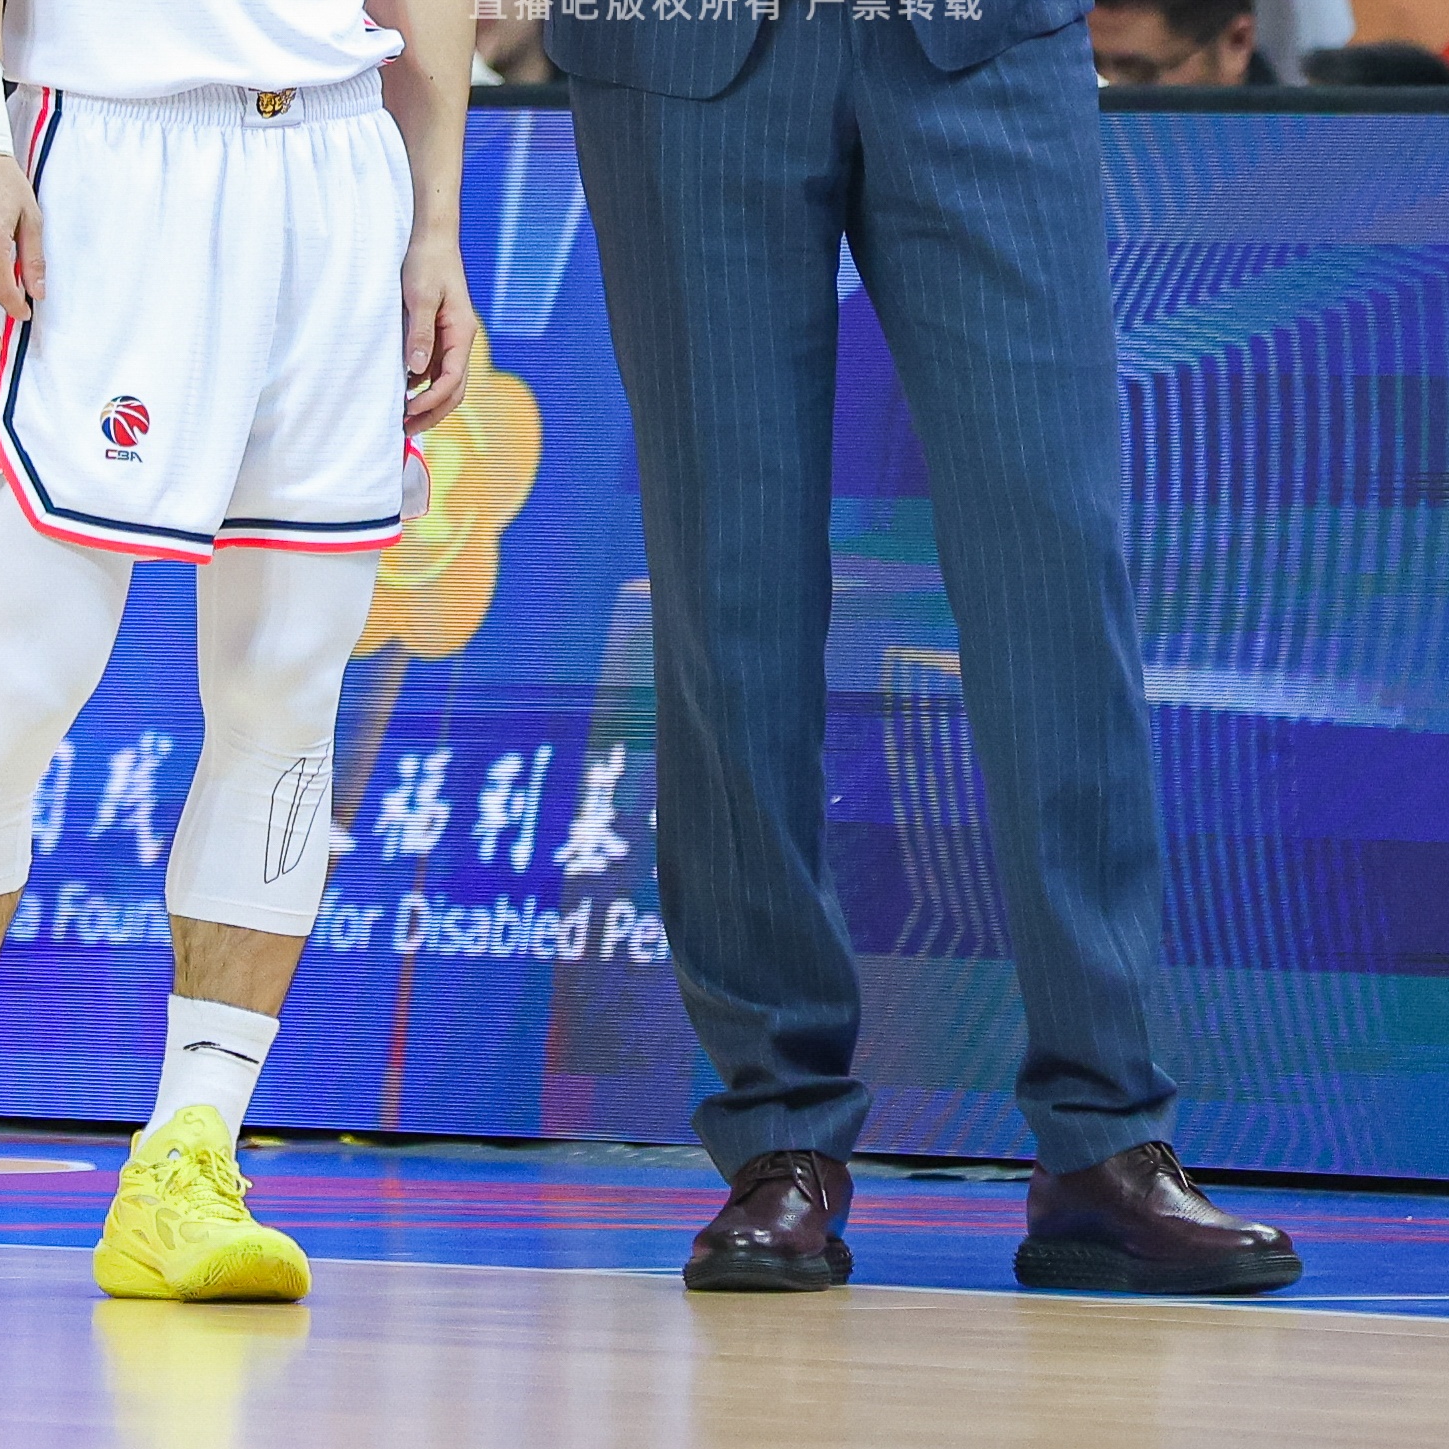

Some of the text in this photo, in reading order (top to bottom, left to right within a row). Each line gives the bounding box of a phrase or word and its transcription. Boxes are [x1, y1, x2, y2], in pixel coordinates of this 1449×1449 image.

[105, 448, 143, 463] CBA
[310, 887, 384, 951] for
[392, 893, 593, 961] Disabled
